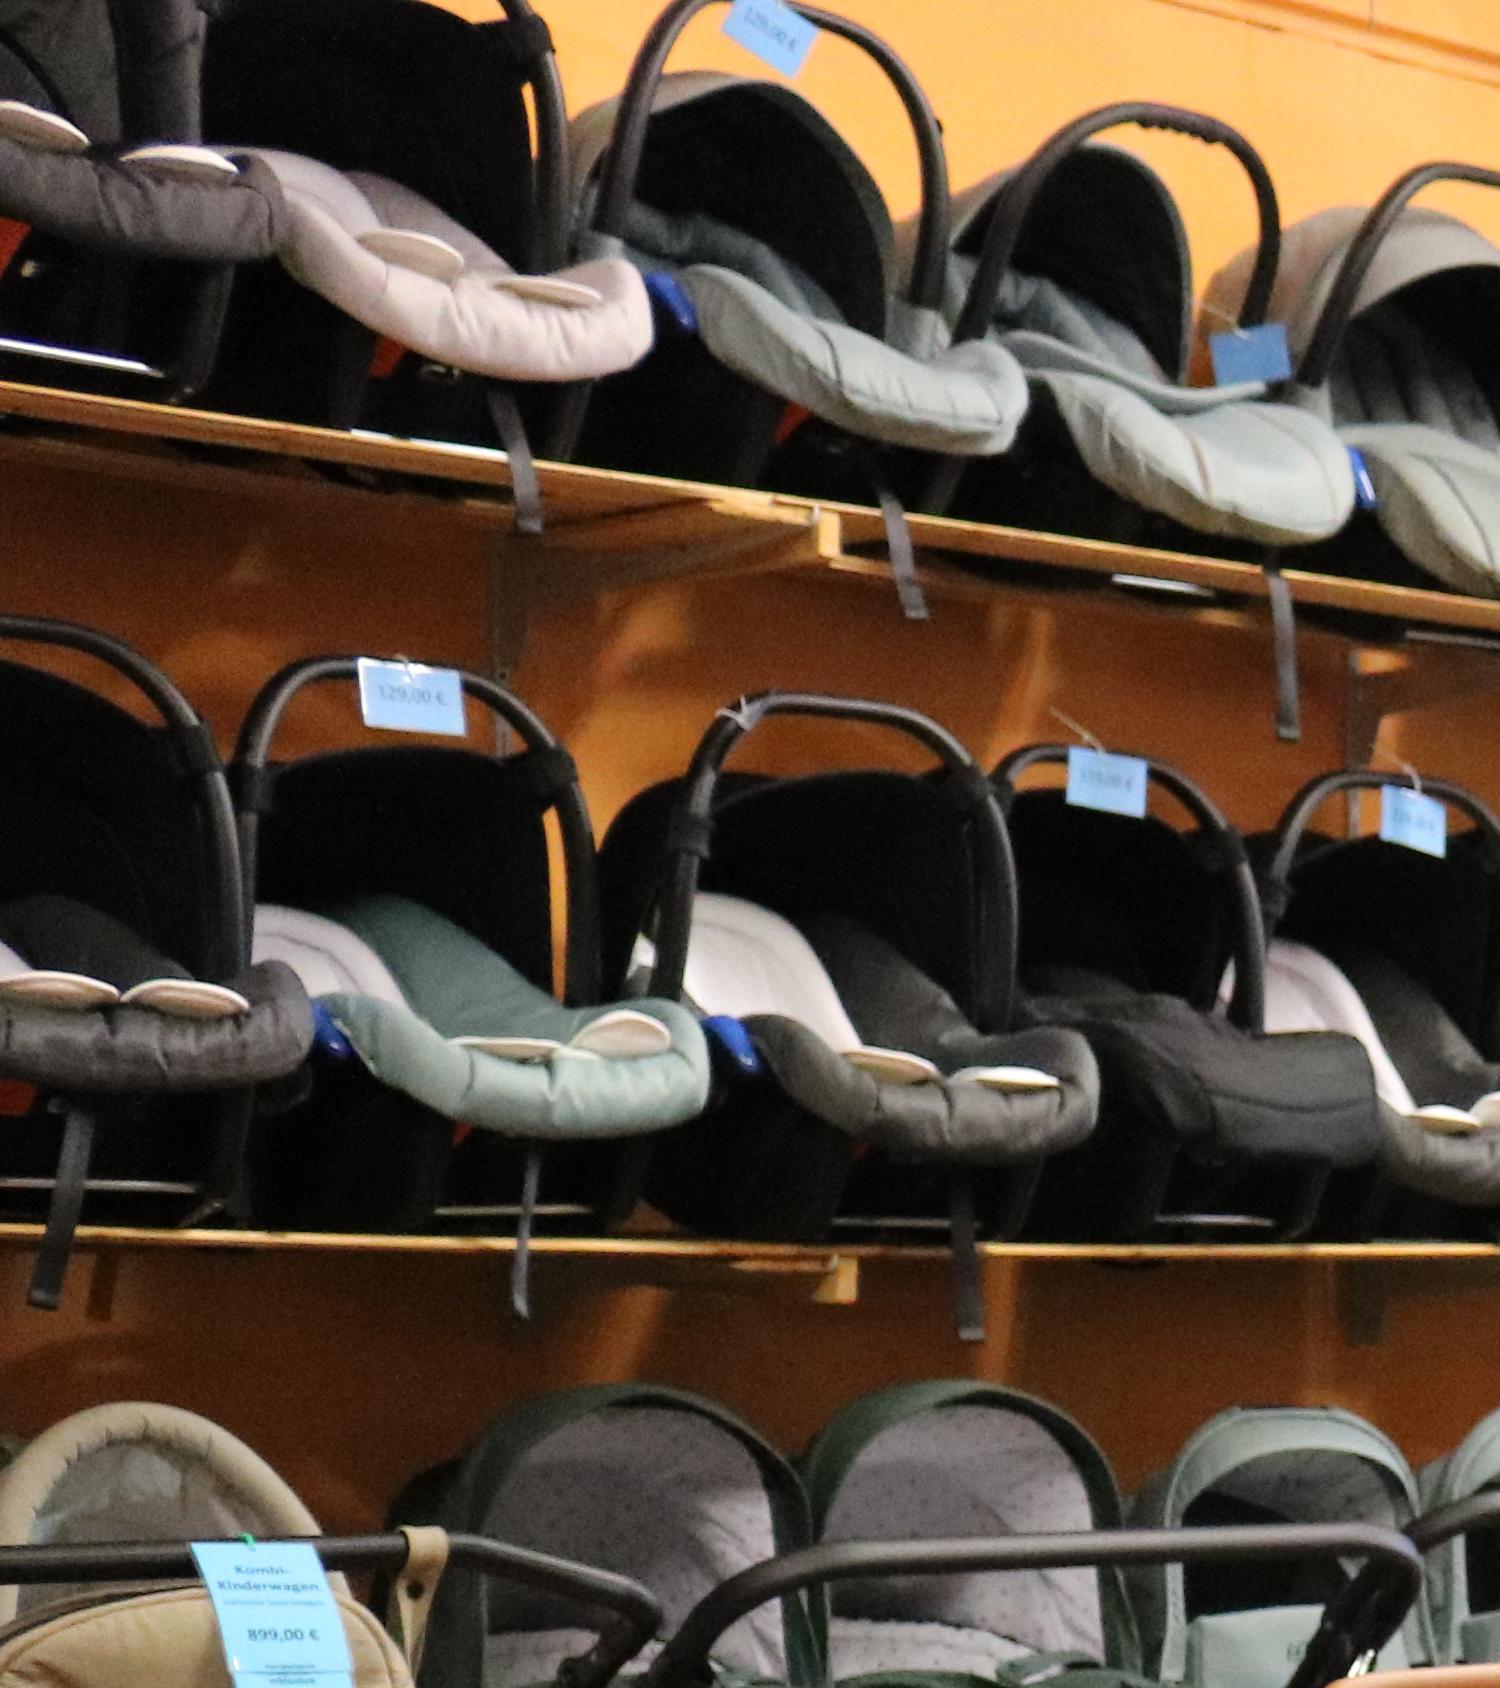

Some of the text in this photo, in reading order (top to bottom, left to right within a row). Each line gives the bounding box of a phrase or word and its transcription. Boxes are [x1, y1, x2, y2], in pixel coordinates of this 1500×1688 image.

[217, 1580, 320, 1594] Kinderwagen
[247, 1628, 321, 1644] 899,00 €
